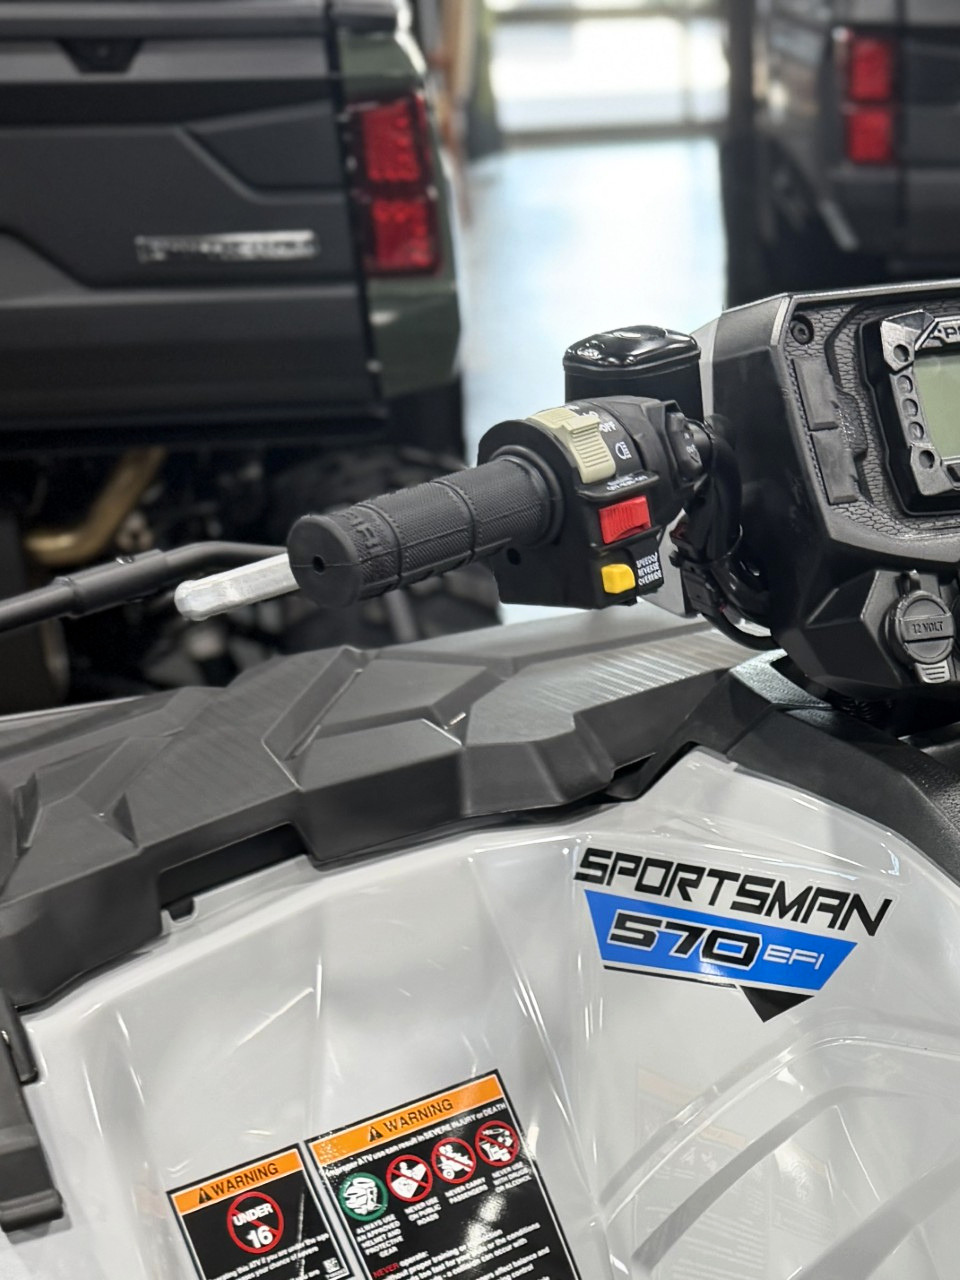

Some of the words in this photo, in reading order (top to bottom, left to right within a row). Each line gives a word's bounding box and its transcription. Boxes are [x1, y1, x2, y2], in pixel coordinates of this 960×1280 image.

[912, 623, 921, 634] 12
[922, 621, 943, 633] VOLT
[573, 847, 893, 937] SPORTSMAN
[607, 909, 763, 971] 570
[763, 943, 825, 970] EFI
[382, 1097, 454, 1134] WARNING
[357, 1153, 373, 1165] ATV
[422, 1124, 448, 1140] SEVERE
[447, 1113, 477, 1130] INJURY
[482, 1102, 506, 1116] DEATH
[210, 1161, 279, 1197] WARNING
[444, 1184, 466, 1198] NEVER
[465, 1176, 486, 1190] CARRY
[494, 1185, 505, 1194] OR
[504, 1173, 532, 1189] ALCOHOL
[448, 1183, 489, 1205] PASSENGERS
[231, 1201, 274, 1227] UNDER
[404, 1201, 426, 1215] NEVER
[425, 1196, 439, 1206] USE
[355, 1219, 382, 1235] ALWAYS
[381, 1213, 397, 1224] USE
[356, 1234, 367, 1243] AN
[366, 1220, 401, 1239] APPROVED
[244, 1223, 275, 1251] 16
[364, 1235, 404, 1256] PROTECTIVE
[372, 1262, 400, 1279] NEVER
